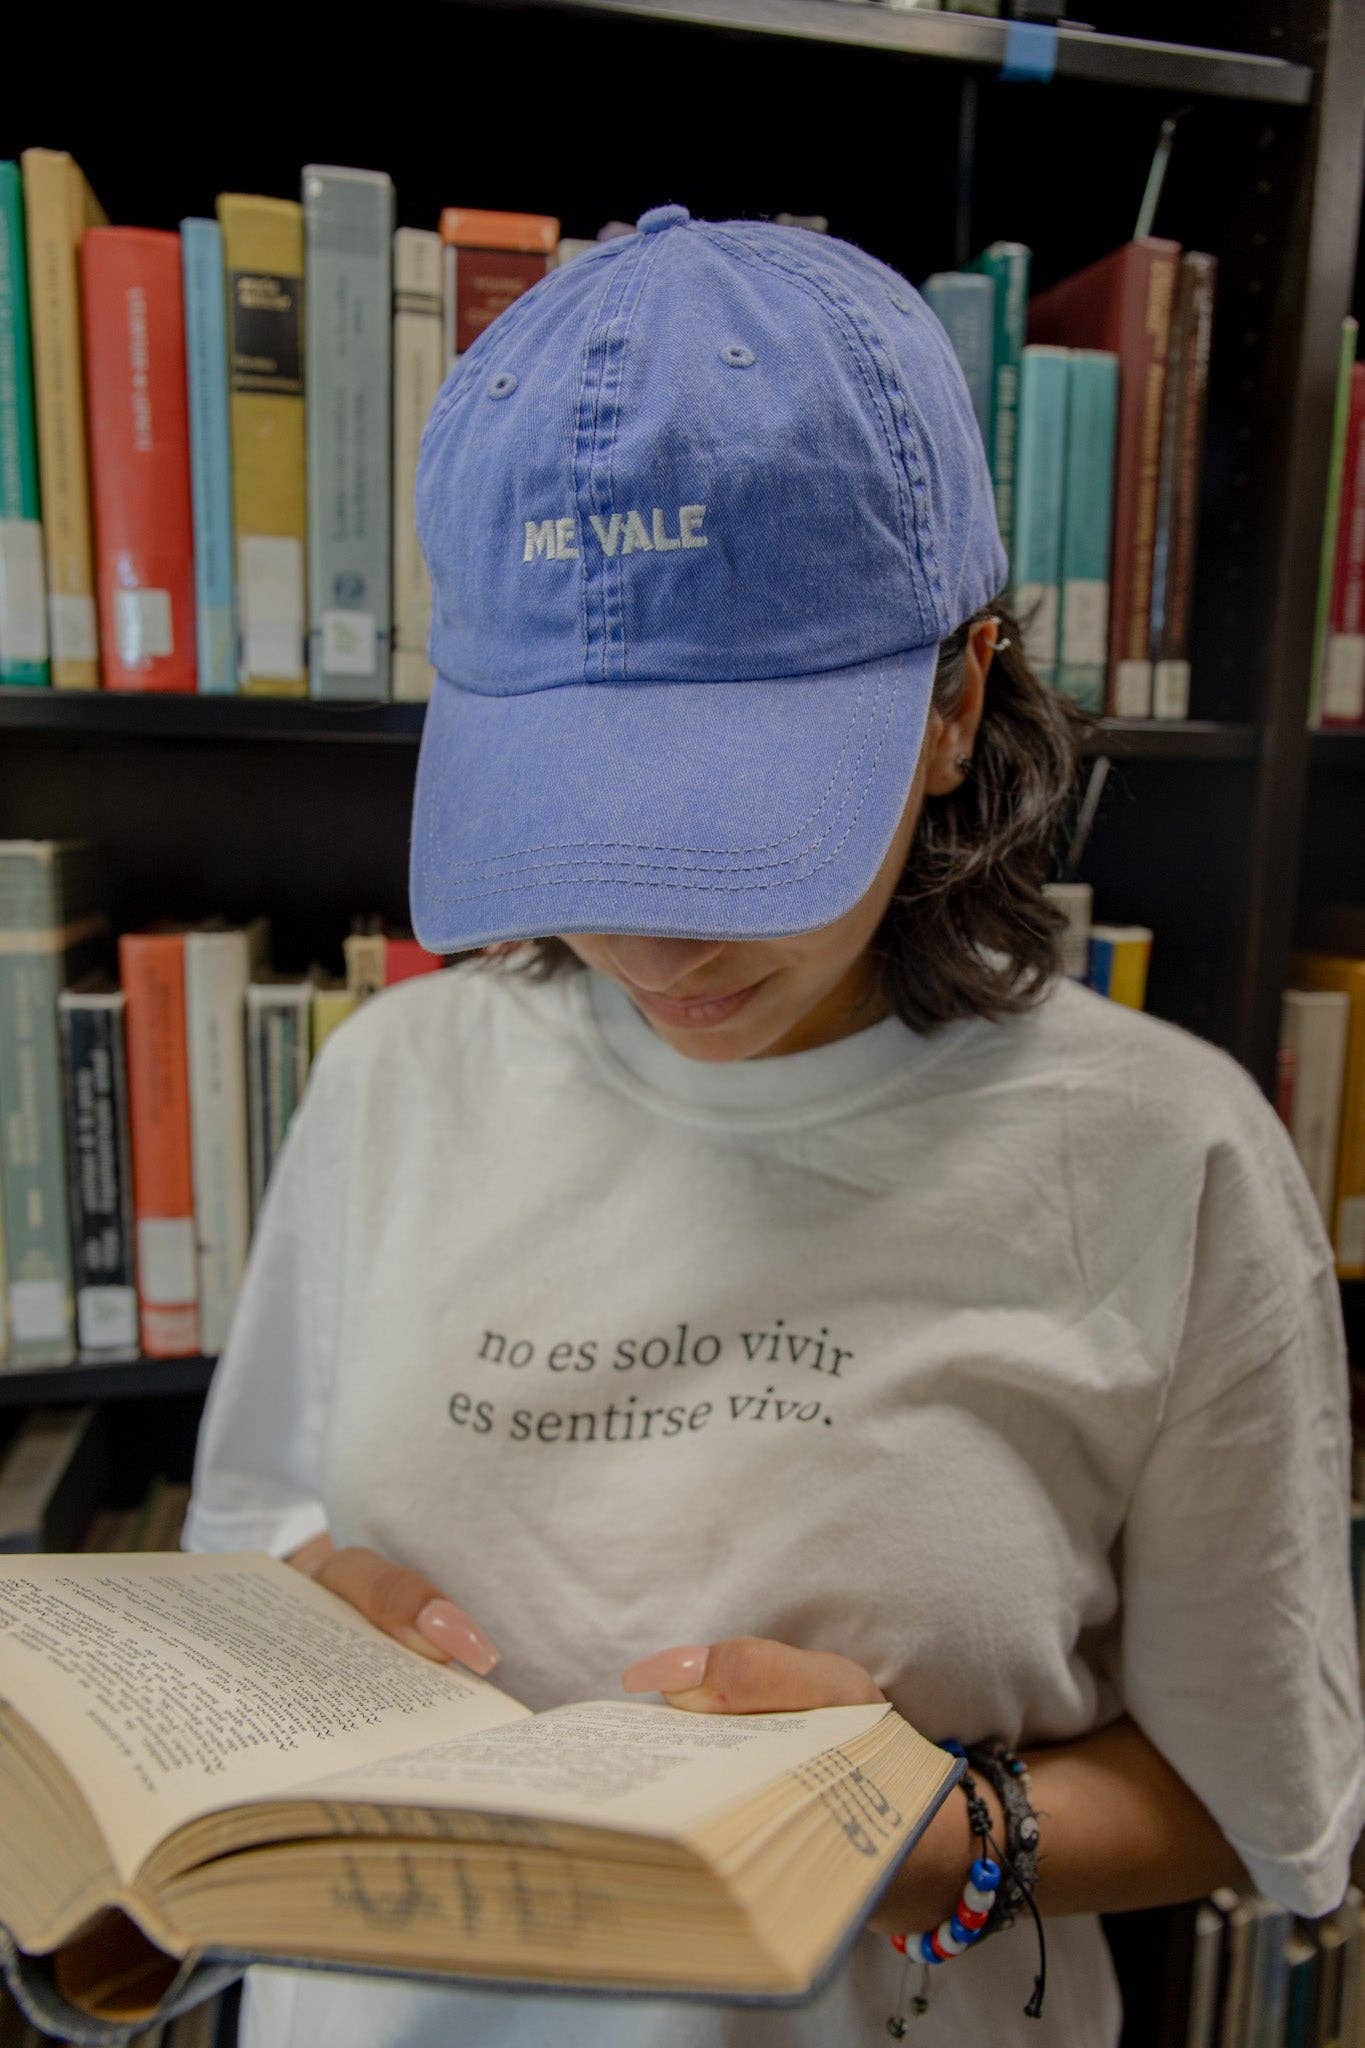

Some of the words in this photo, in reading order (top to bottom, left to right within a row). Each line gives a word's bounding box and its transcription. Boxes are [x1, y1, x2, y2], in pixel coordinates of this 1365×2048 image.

[523, 517, 580, 563] ME
[589, 504, 708, 557] VALE
[477, 1329, 535, 1369] no
[547, 1337, 597, 1372] es
[613, 1323, 721, 1371] solo
[739, 1318, 855, 1378] vivir
[448, 1391, 494, 1434] es
[509, 1395, 713, 1443] sentirse
[728, 1384, 833, 1427] vivo.
